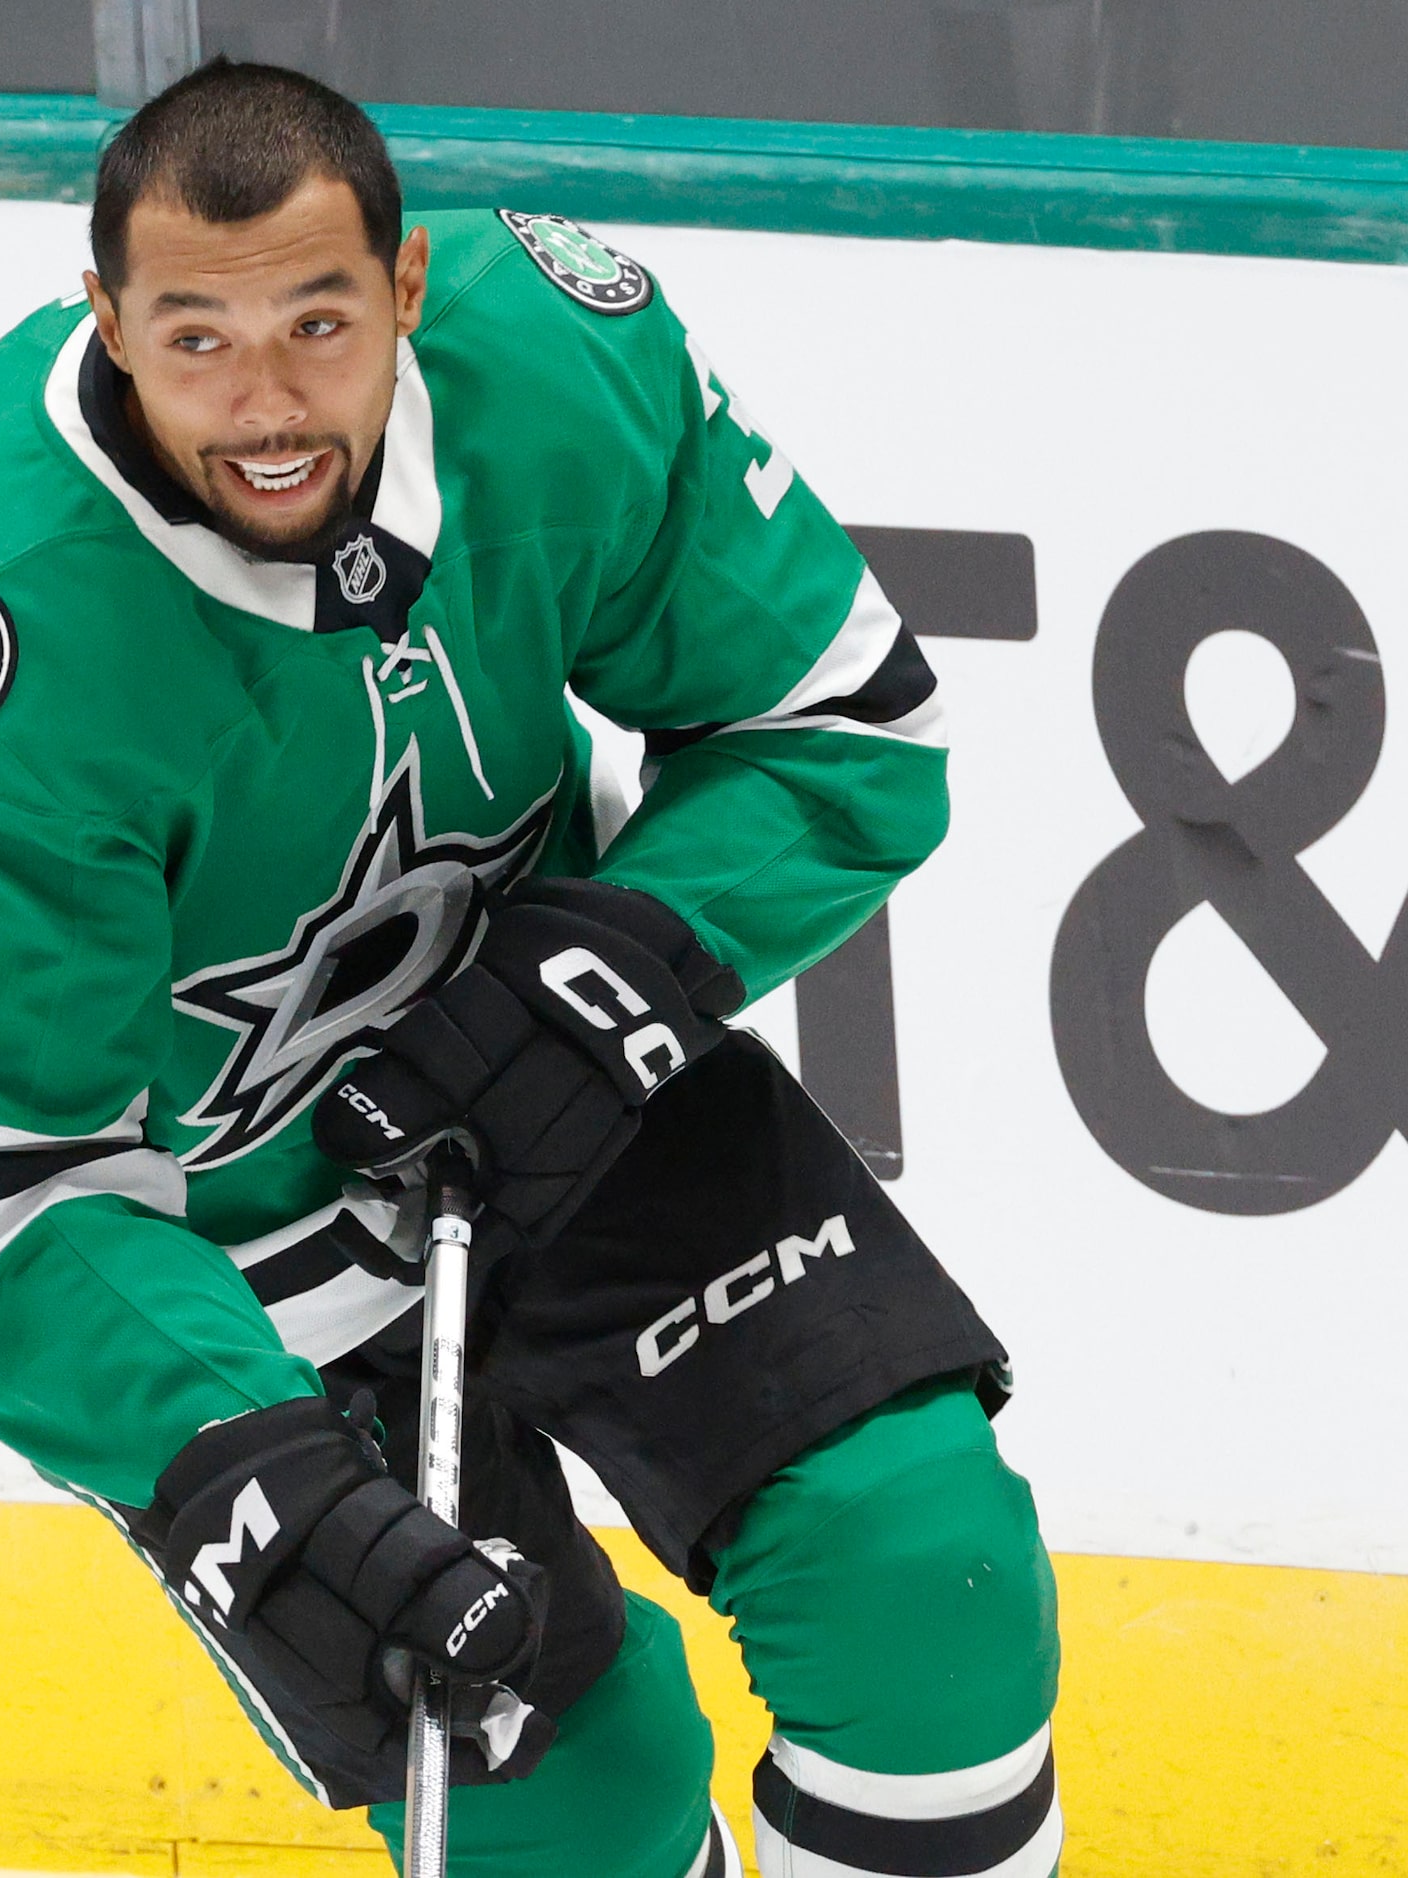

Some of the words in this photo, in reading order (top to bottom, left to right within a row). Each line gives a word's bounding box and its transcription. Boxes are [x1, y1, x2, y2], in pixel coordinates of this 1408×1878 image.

[350, 553, 371, 594] NHL
[337, 1083, 406, 1140] CCM
[636, 1214, 856, 1377] CCM
[184, 1476, 281, 1629] M
[446, 1583, 509, 1658] CCM
